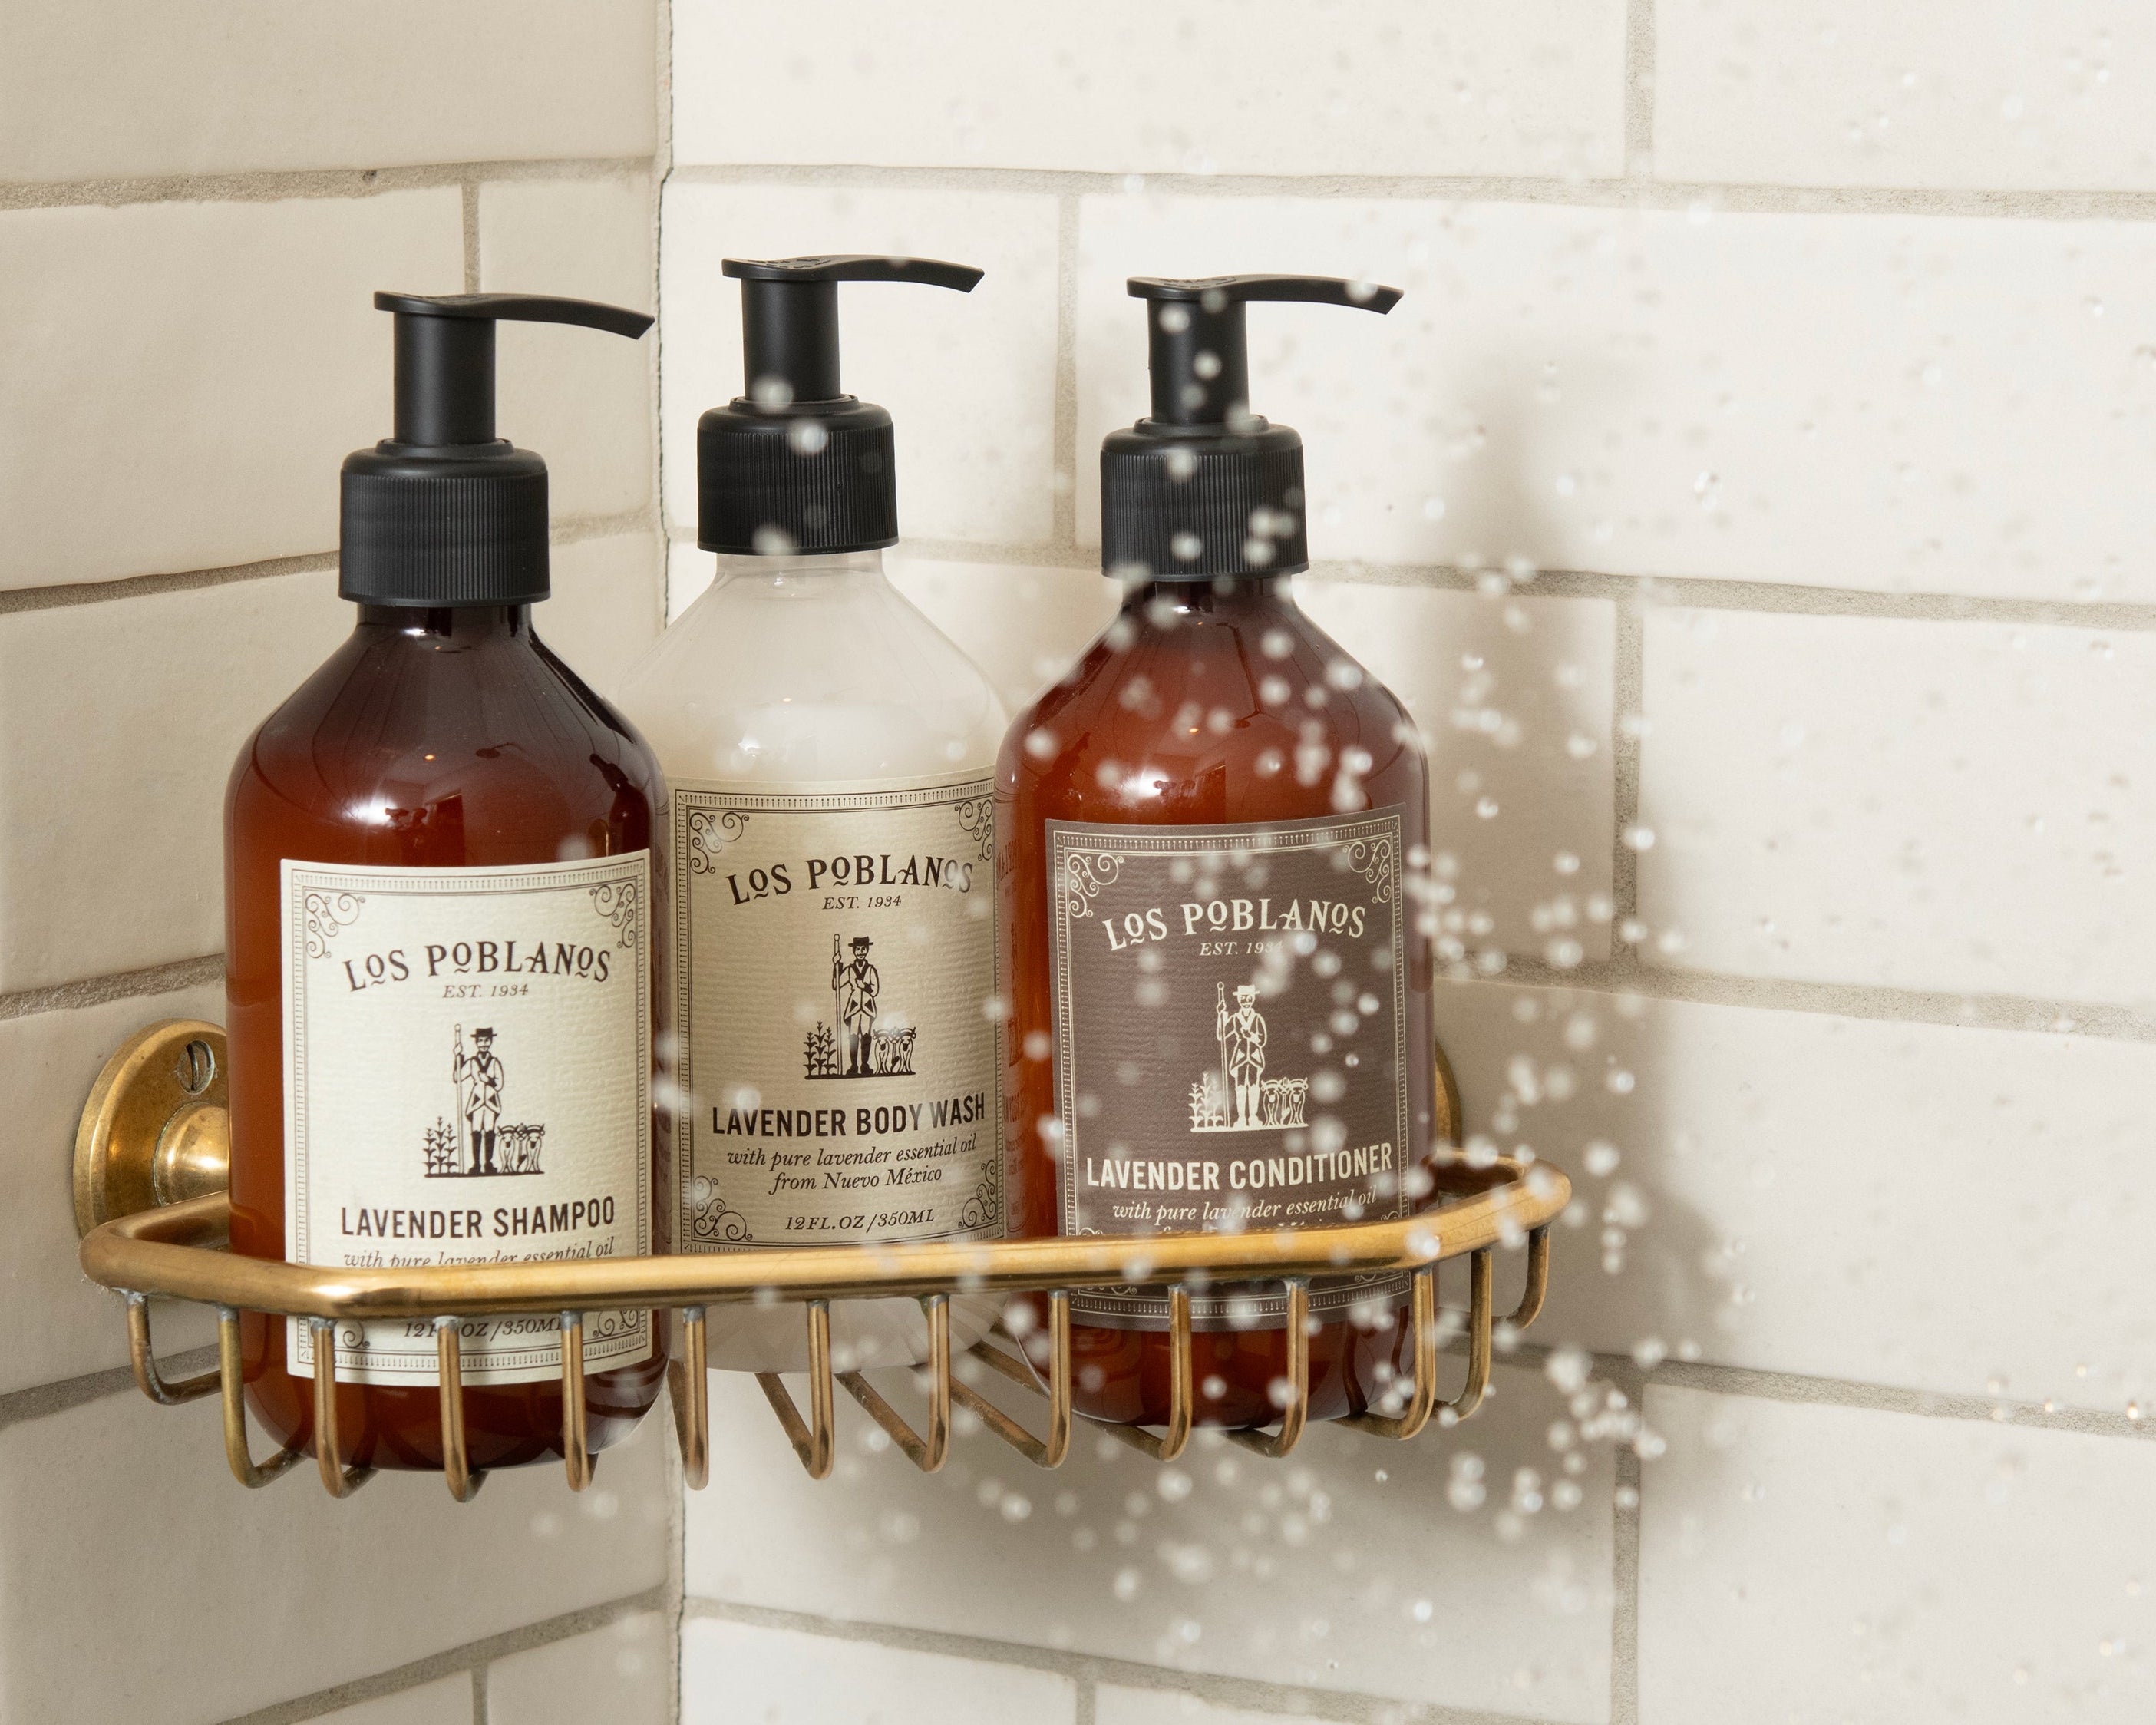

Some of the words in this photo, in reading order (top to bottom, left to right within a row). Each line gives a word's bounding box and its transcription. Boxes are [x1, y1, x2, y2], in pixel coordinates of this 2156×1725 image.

[725, 864, 792, 906] LOS
[804, 854, 973, 894] POBLANOS
[821, 896, 860, 910] EST.
[867, 894, 902, 908] 1934
[1101, 907, 1168, 952] LOS
[1180, 898, 1366, 939] POBLANOS
[342, 949, 410, 993] LOS
[424, 940, 611, 983] POBLANOS
[1199, 941, 1239, 957] EST.
[442, 984, 482, 999] EST.
[490, 983, 529, 997] 1934
[712, 1106, 847, 1137] LAVENDER
[856, 1103, 923, 1135] BODY
[929, 1092, 986, 1129] WASH
[727, 1148, 767, 1166] with
[768, 1151, 811, 1172] pure
[817, 1148, 892, 1166] lavender
[896, 1138, 958, 1162] essential
[960, 1132, 977, 1153] oil
[1086, 1158, 1219, 1191] LAVENDER
[1230, 1142, 1393, 1189] CONDITIONER
[768, 1171, 817, 1195] from
[822, 1172, 880, 1189] Nuevo
[884, 1165, 943, 1187] México
[341, 1207, 483, 1238] LAVENDER
[493, 1195, 615, 1238] SHAMPOO
[1112, 1201, 1151, 1219] with
[1154, 1205, 1197, 1226] pure
[1202, 1199, 1282, 1221] lavender
[1286, 1189, 1355, 1215] essential
[1358, 1185, 1378, 1206] oil
[344, 1249, 383, 1267] with
[596, 1235, 614, 1257] oil
